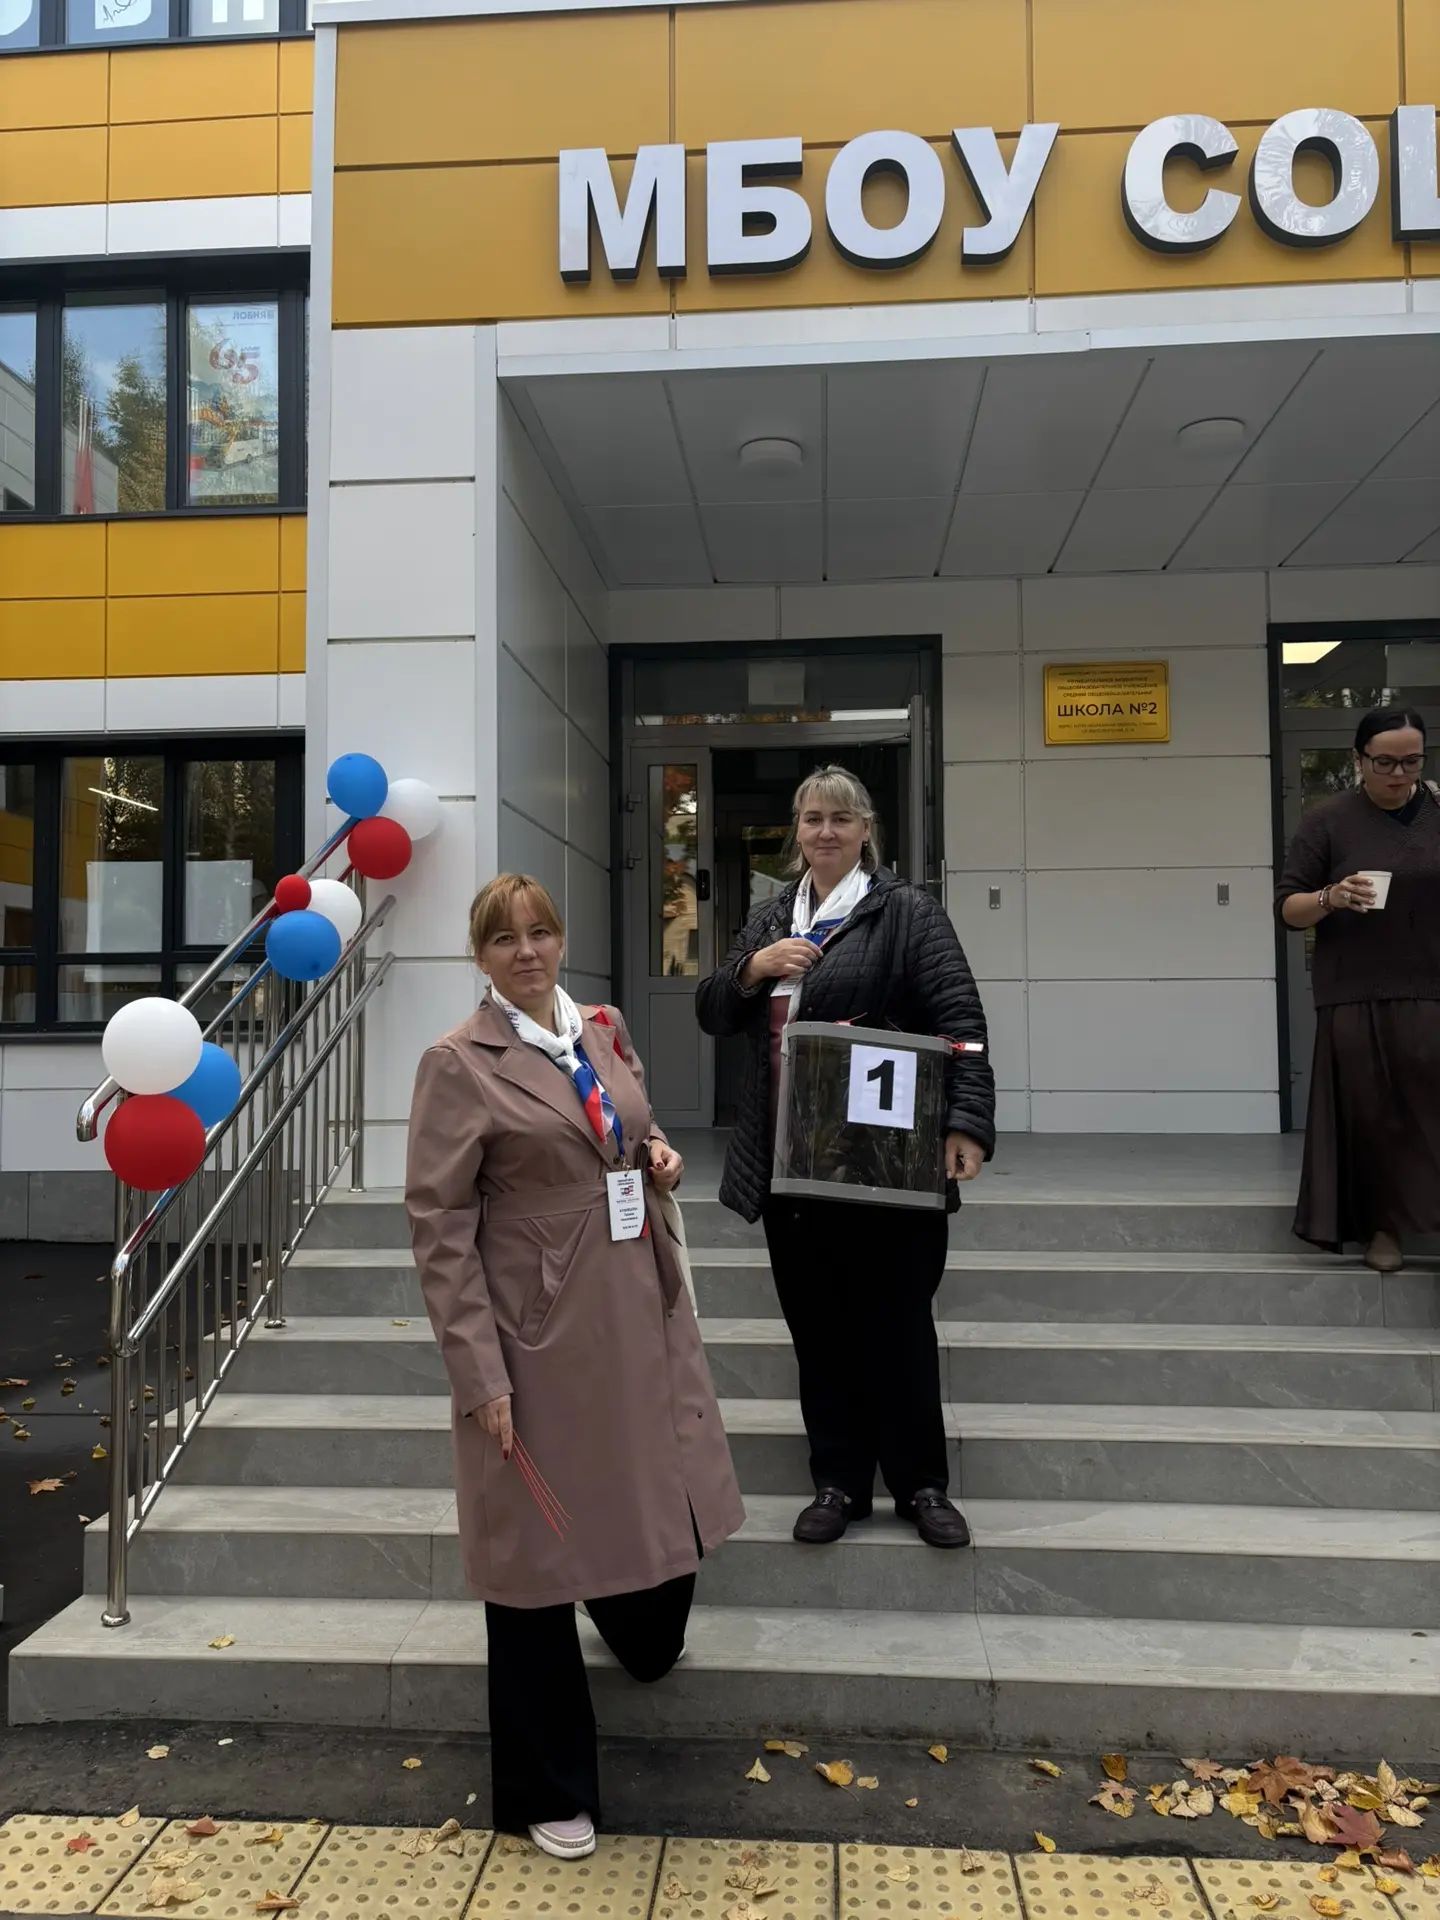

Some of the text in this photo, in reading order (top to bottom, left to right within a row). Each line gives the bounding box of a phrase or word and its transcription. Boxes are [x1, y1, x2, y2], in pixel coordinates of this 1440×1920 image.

[559, 122, 1060, 284] МБОУ
[208, 338, 261, 385] 65
[1057, 702, 1158, 717] ШКОЛА №2
[867, 1059, 895, 1111] 1
